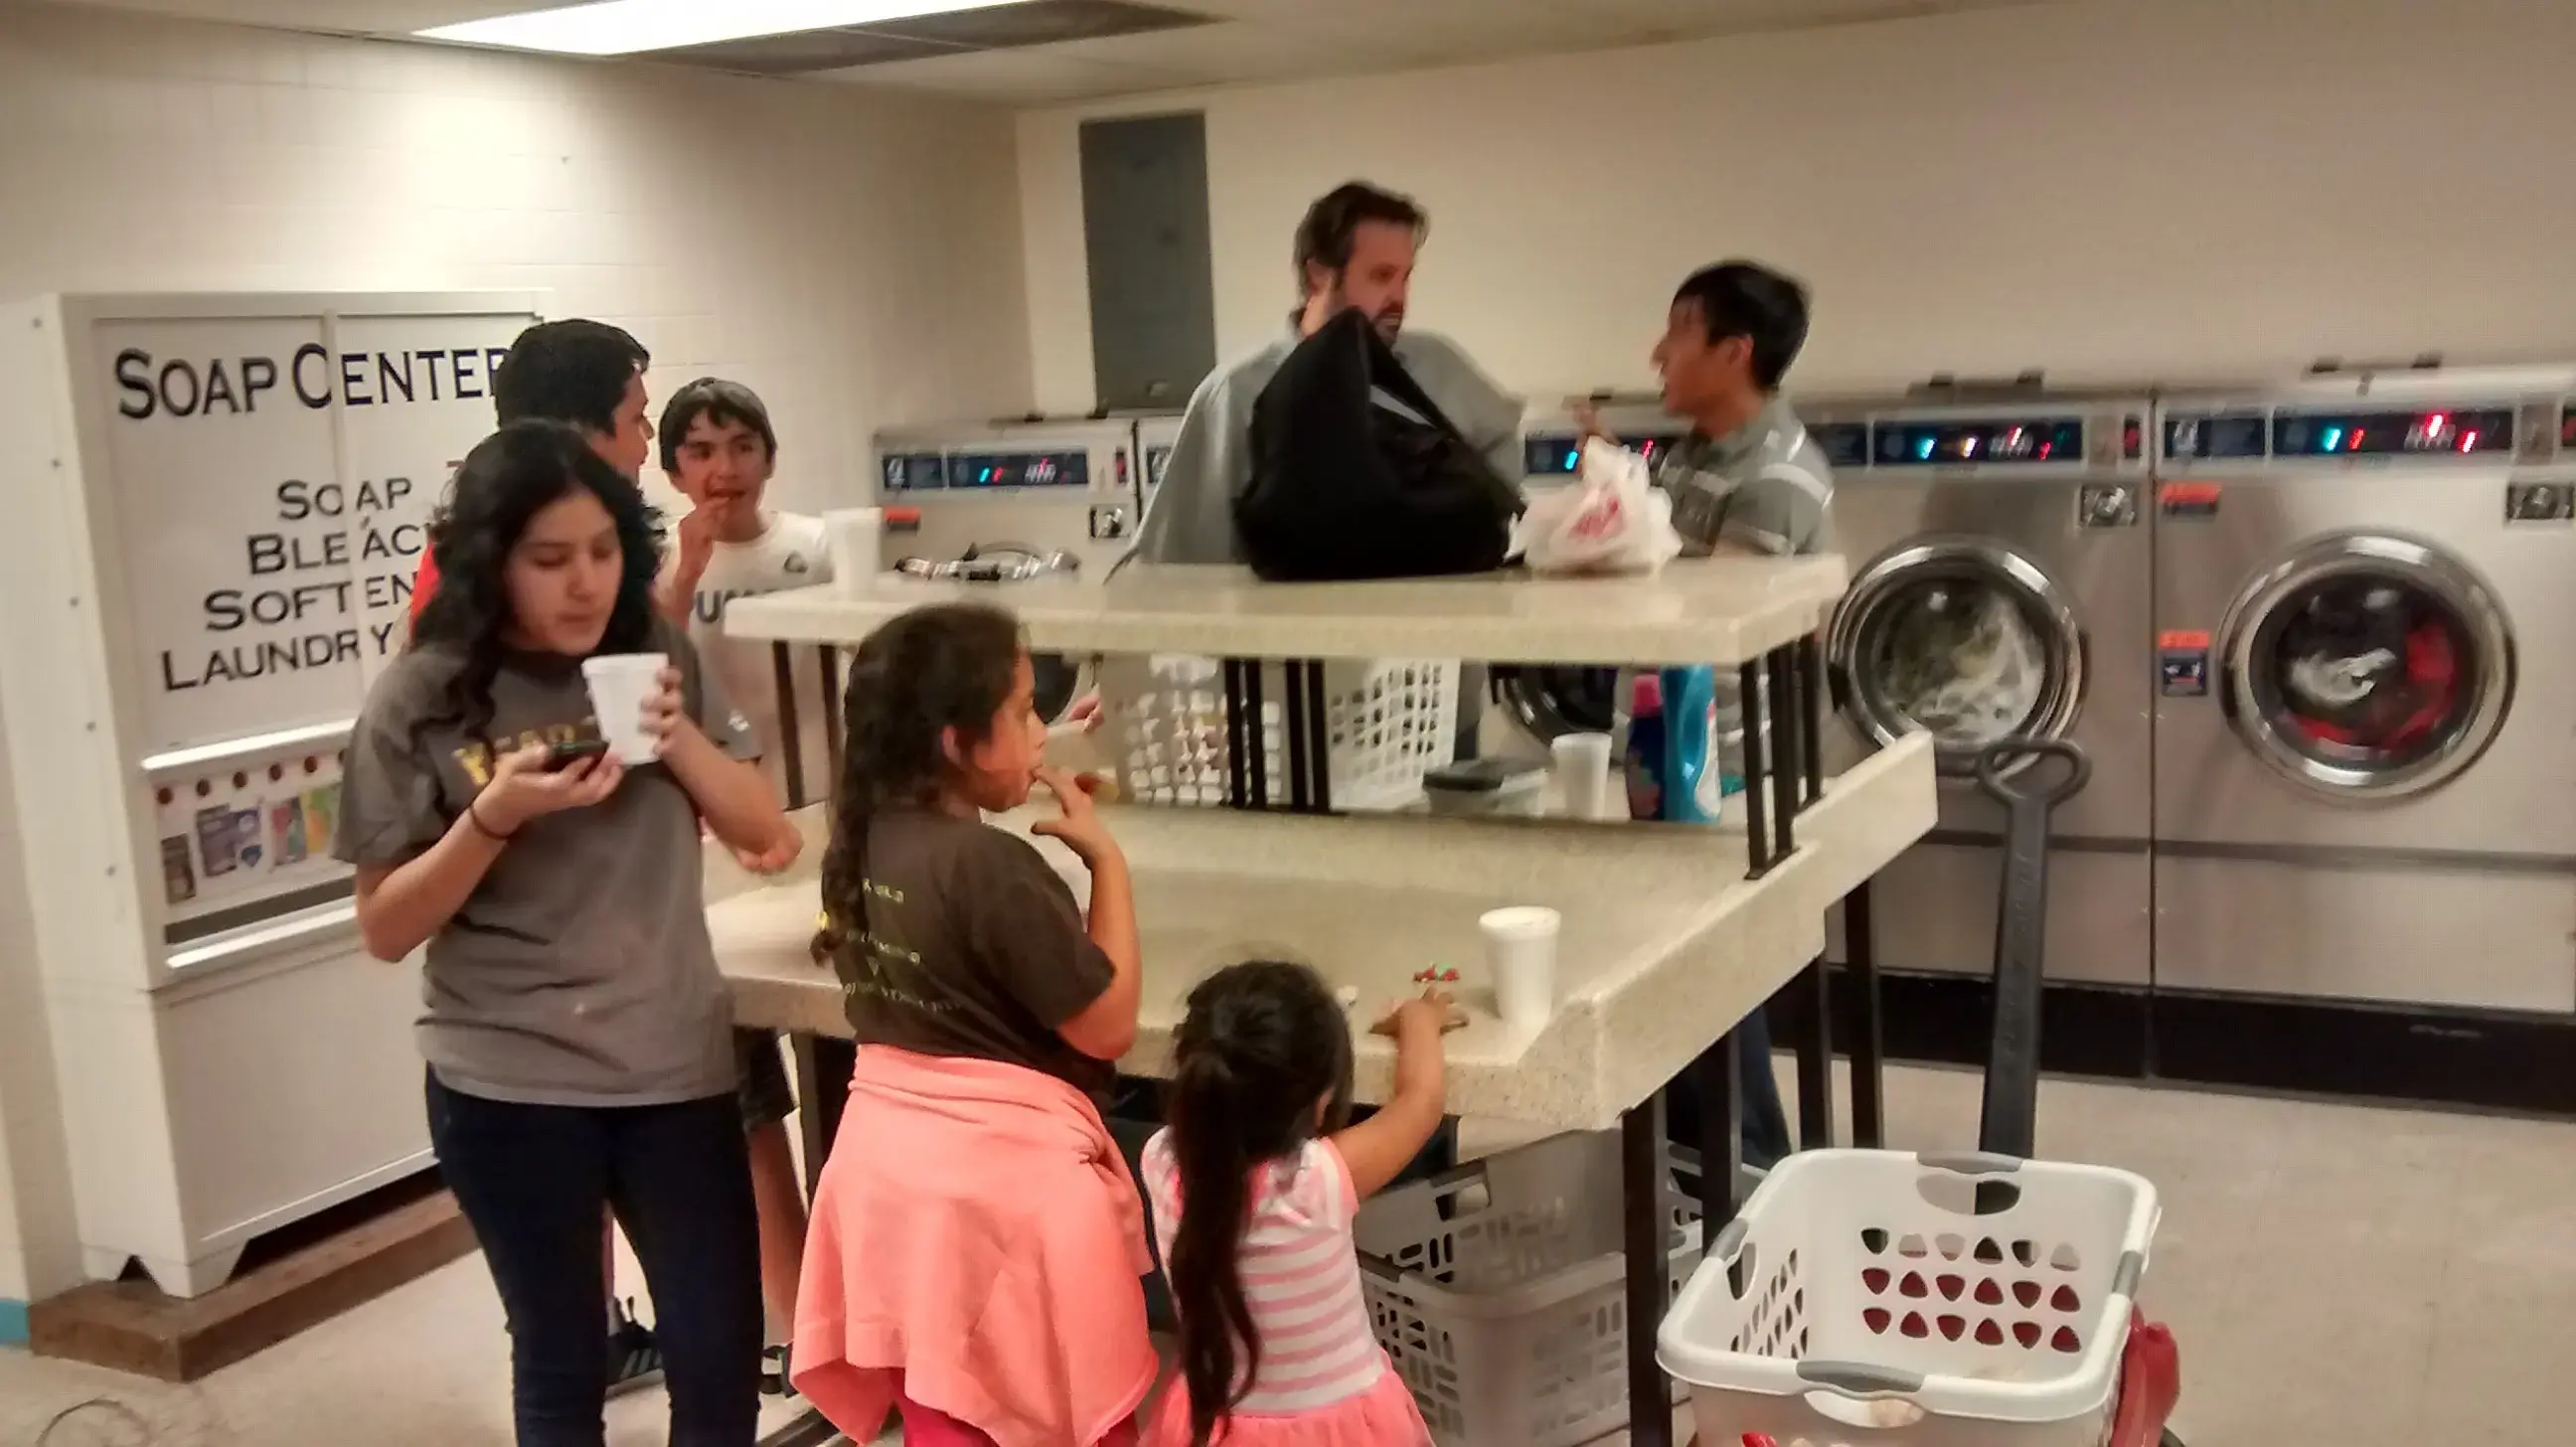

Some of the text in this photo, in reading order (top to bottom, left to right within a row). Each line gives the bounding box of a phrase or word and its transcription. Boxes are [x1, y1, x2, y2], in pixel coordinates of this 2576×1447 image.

[114, 347, 278, 419] SOAP
[277, 477, 412, 520] SOAP
[247, 523, 430, 574] BLEAC
[161, 622, 396, 692] LAUNDRY
